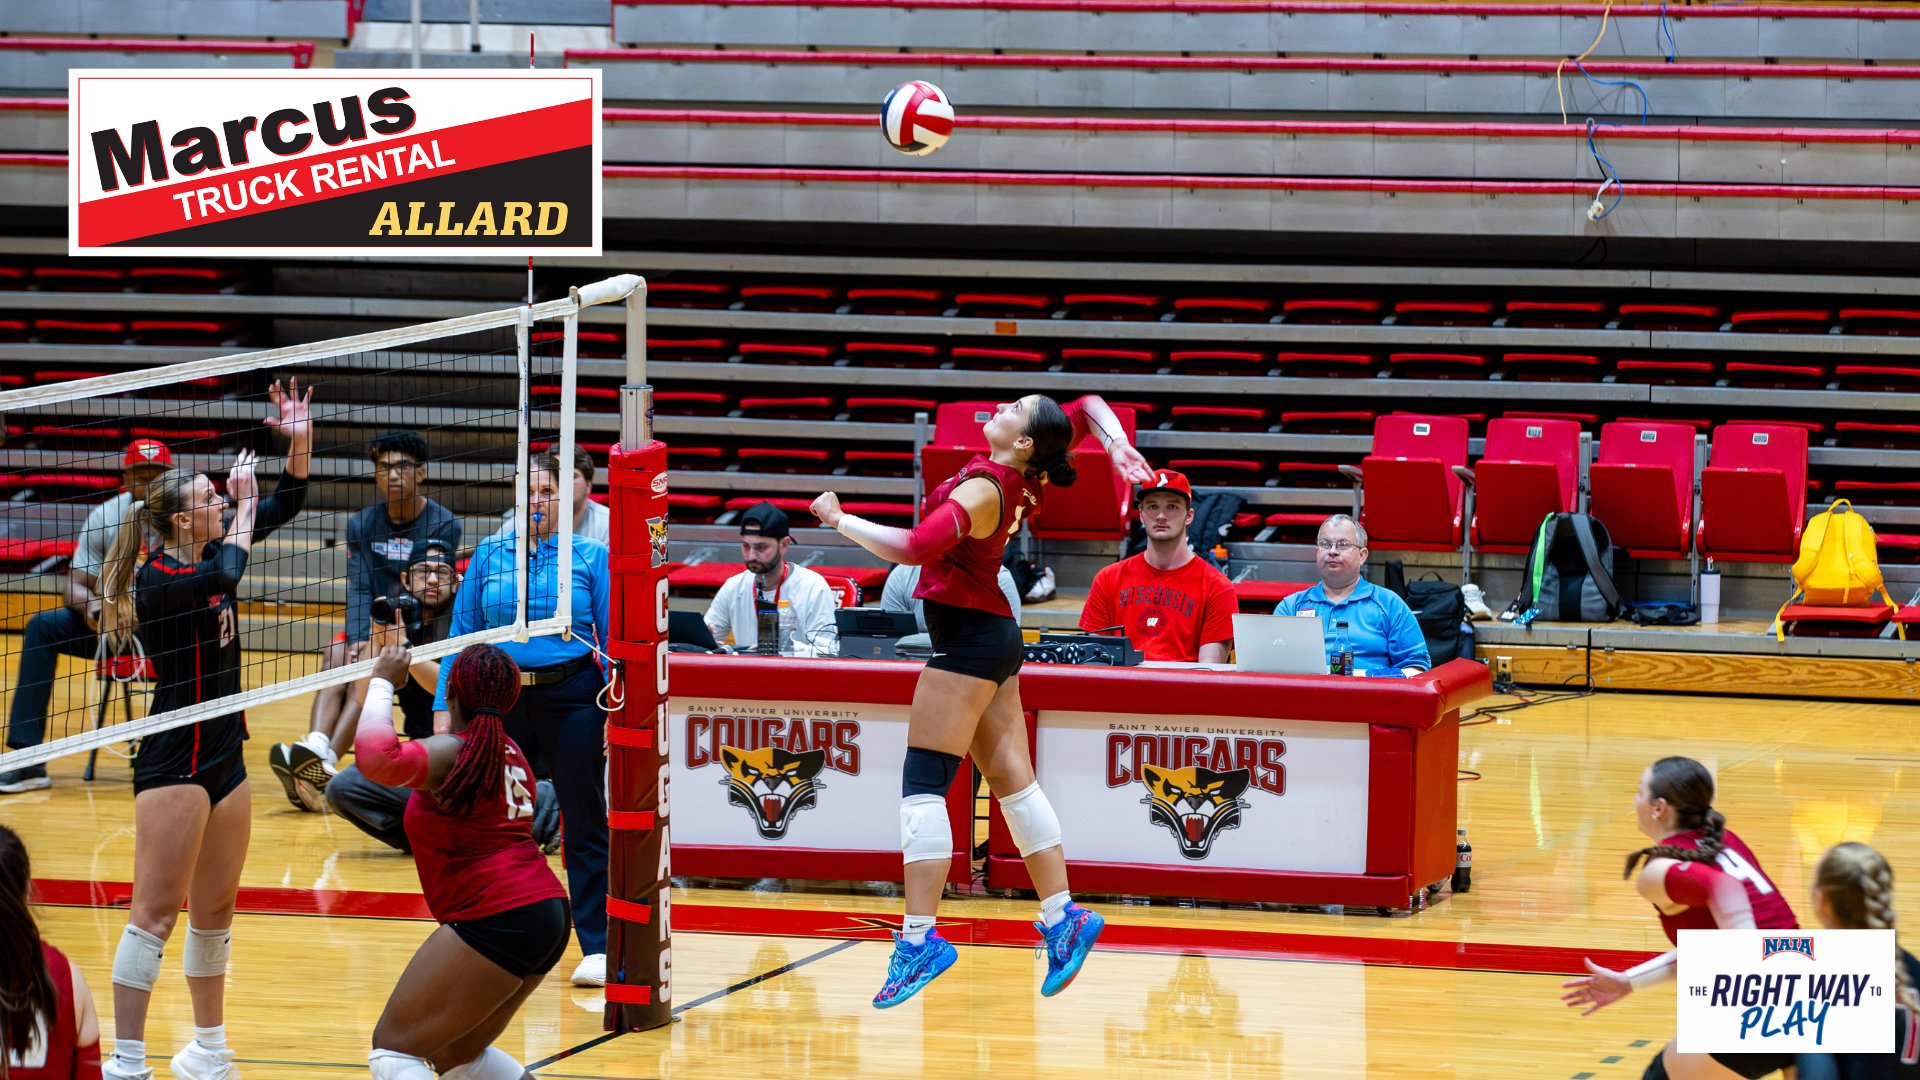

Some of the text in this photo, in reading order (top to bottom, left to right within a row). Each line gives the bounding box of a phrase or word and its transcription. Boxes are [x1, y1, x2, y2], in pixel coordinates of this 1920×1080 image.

[1118, 585, 1197, 619] WISCONSIN
[688, 705, 859, 718] SAINT XAVIER UNIVERSITY
[1109, 723, 1285, 737] SAINT XAVIER UNIVERSITY
[685, 714, 861, 776] COUGARS
[1106, 732, 1287, 796] COUGARS
[1715, 847, 1774, 895] 4
